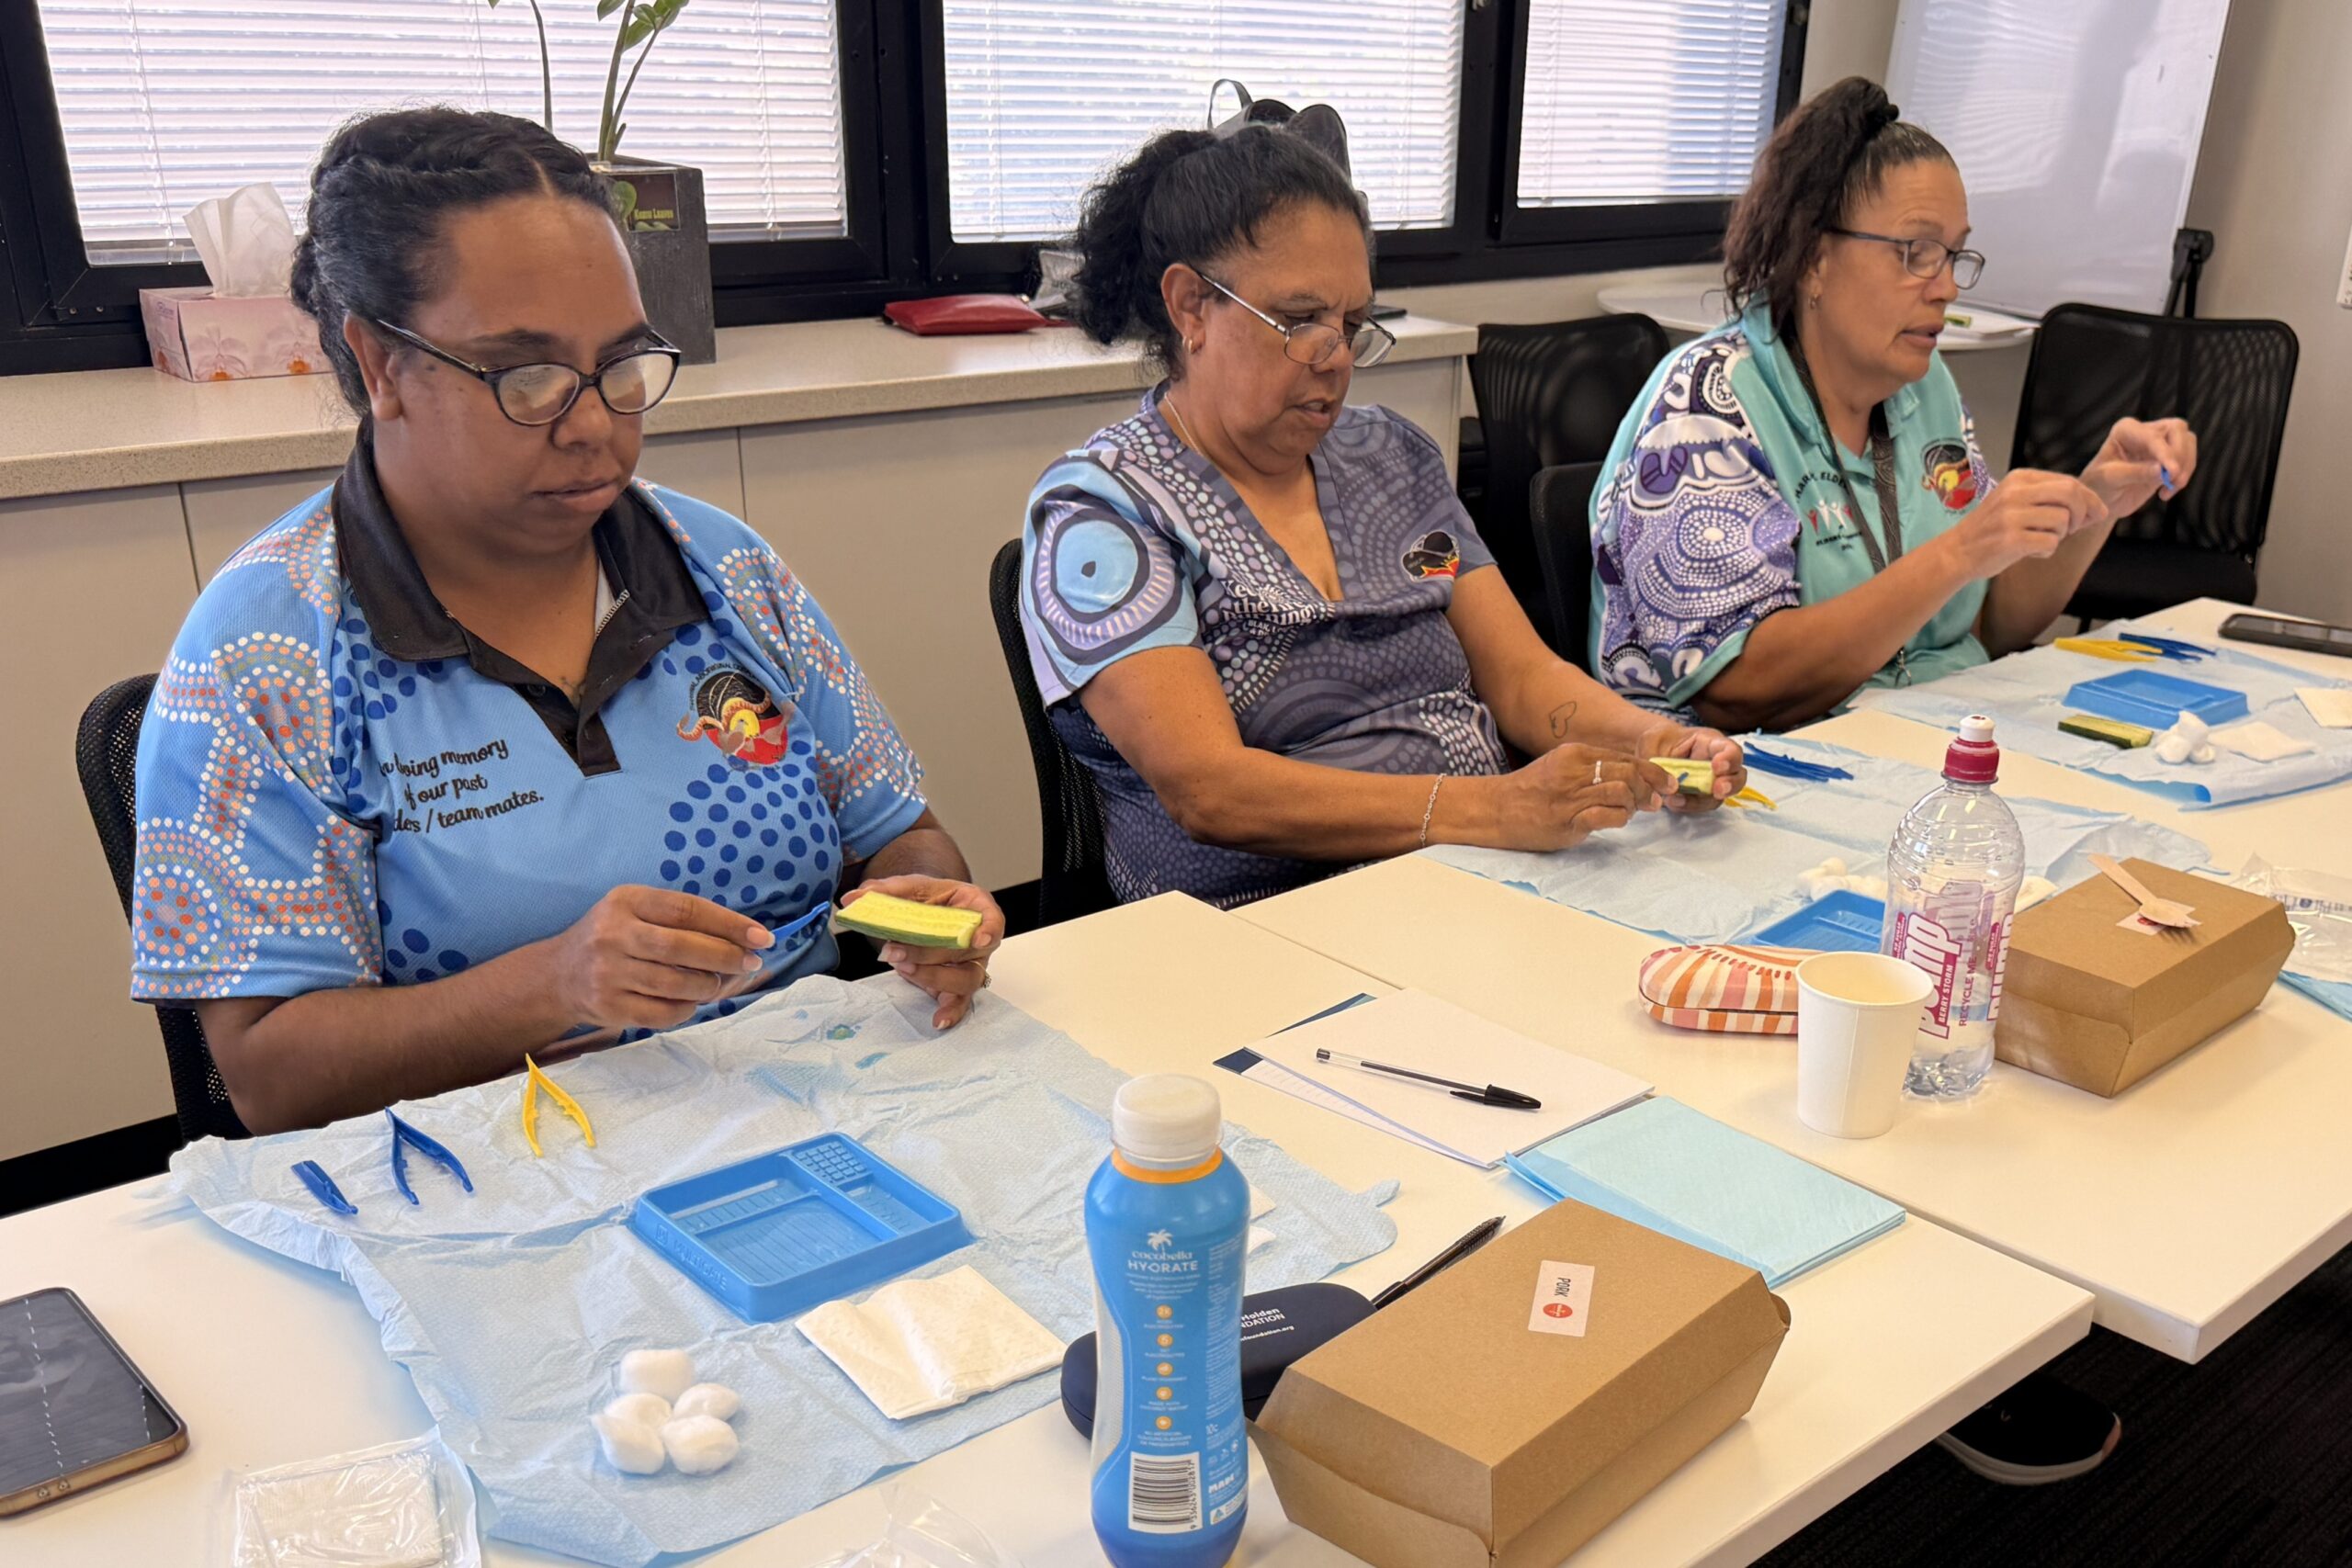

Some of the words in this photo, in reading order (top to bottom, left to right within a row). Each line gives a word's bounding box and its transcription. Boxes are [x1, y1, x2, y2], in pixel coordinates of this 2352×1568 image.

[1233, 598, 1270, 614] the
[418, 781, 448, 803] our
[452, 774, 488, 800] past
[1905, 912, 1963, 1040] pmp
[1966, 956, 1977, 975] ME
[1942, 965, 1954, 994] STORM
[1938, 997, 1951, 1023] BERRY
[1959, 977, 1974, 1026] RECYCLE
[1131, 1250, 1193, 1261] cocobella
[1554, 1277, 1572, 1298] PORK
[1240, 1325, 1295, 1342] foundation.org
